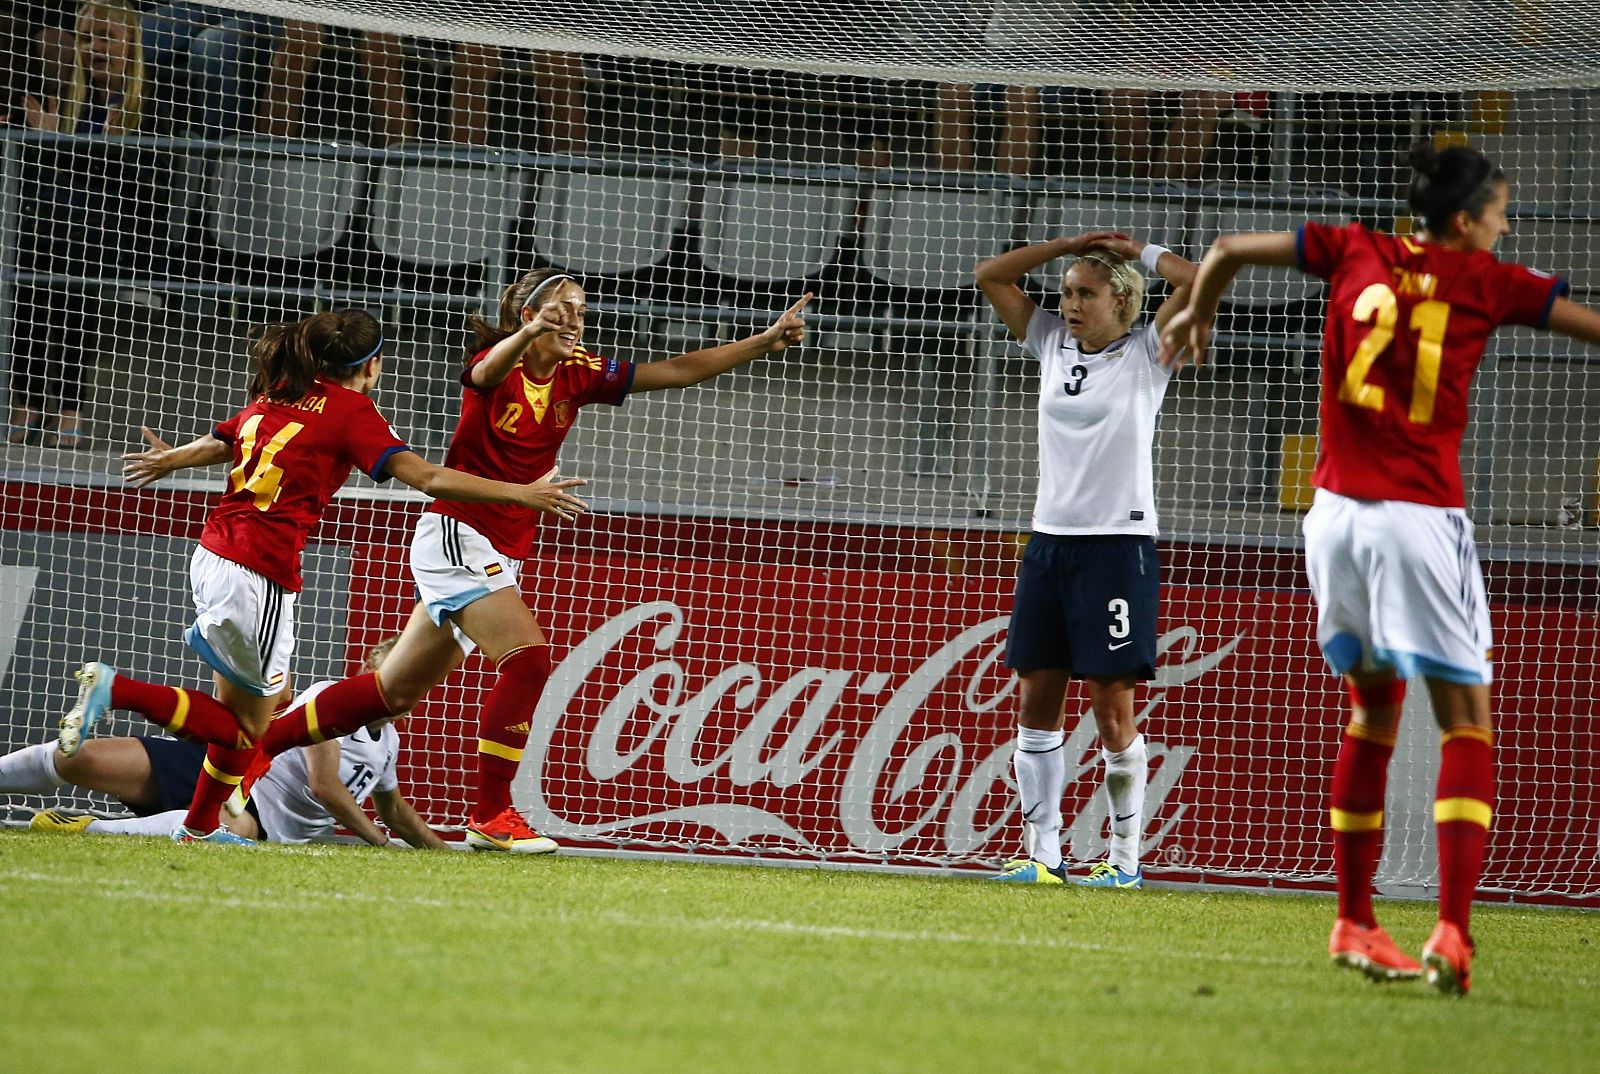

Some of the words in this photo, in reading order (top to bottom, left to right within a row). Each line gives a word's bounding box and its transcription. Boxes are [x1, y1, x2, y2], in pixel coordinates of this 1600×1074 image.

[1338, 283, 1450, 424] 21
[1064, 364, 1088, 396] 3
[496, 403, 523, 433] 12
[231, 414, 305, 512] 14
[1108, 598, 1130, 639] 3
[510, 600, 1247, 861] Coca-Cola
[346, 764, 374, 799] 15
